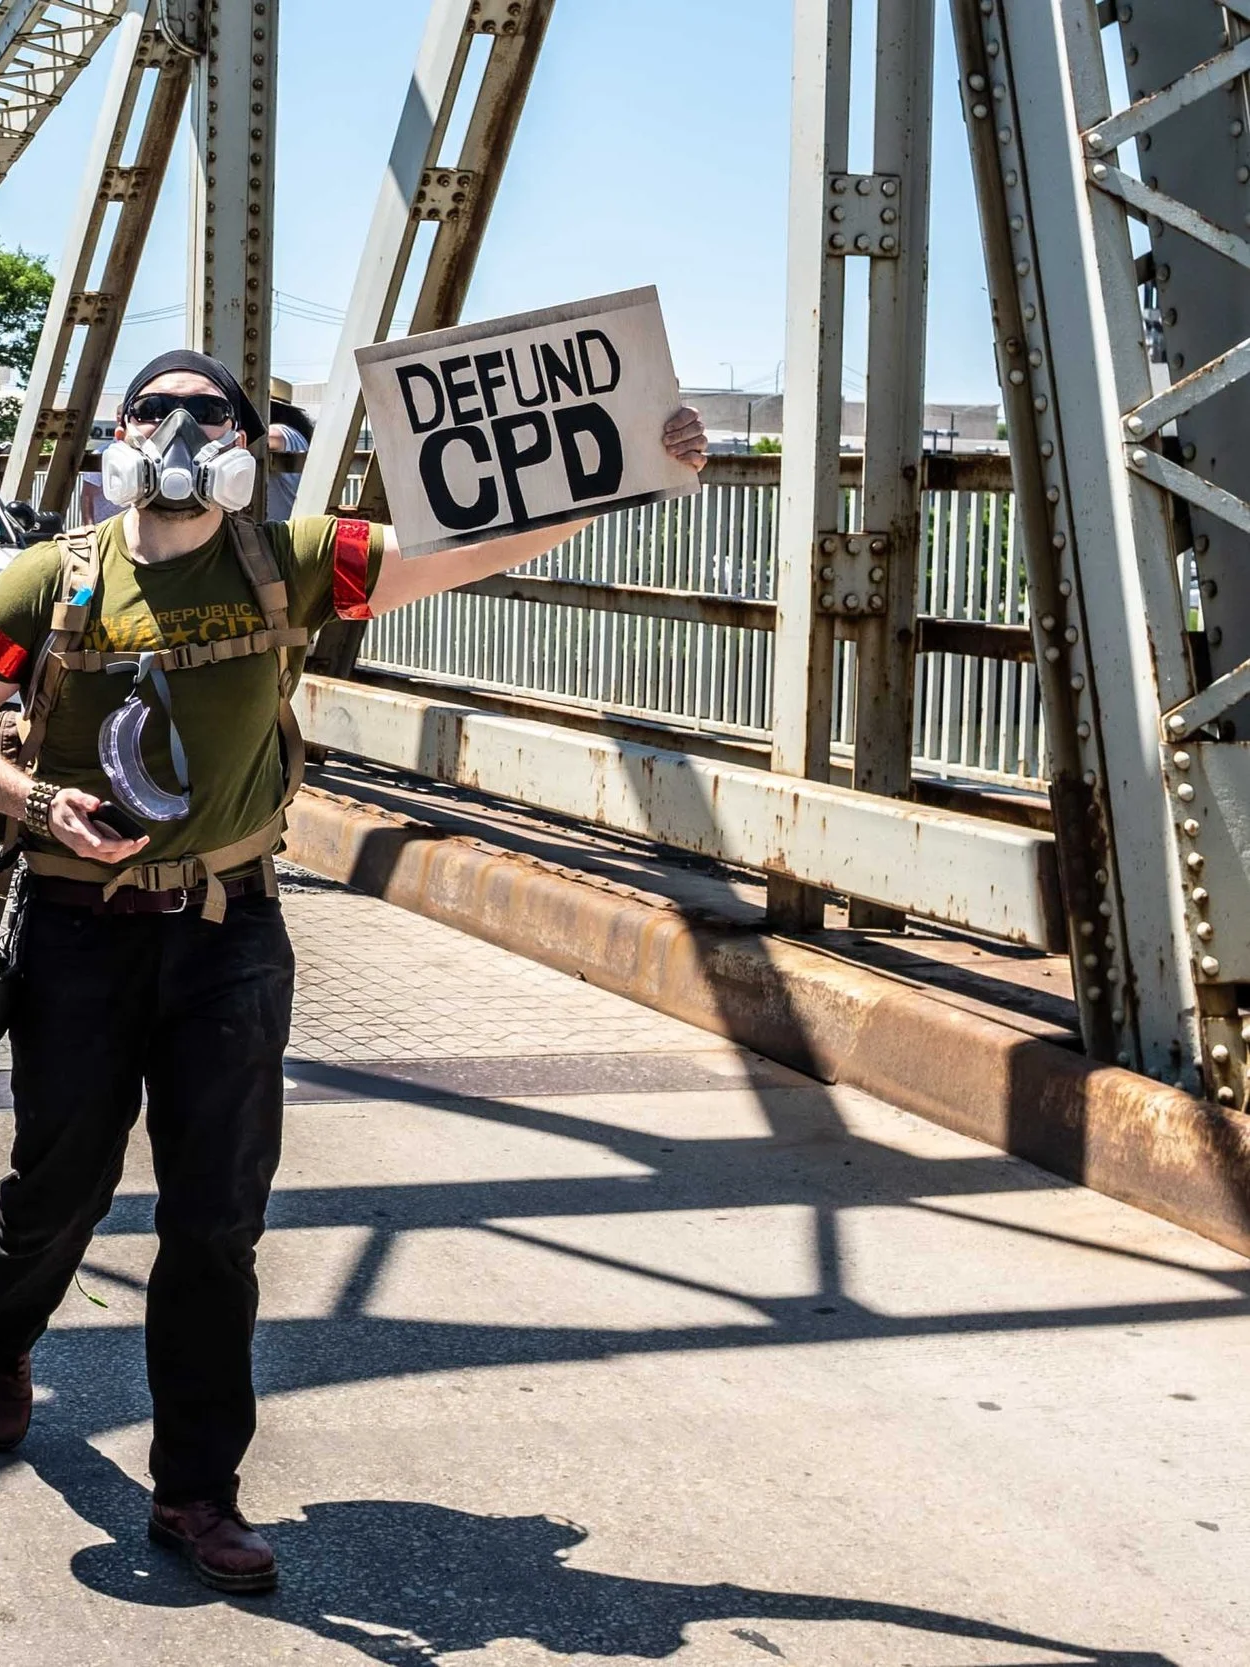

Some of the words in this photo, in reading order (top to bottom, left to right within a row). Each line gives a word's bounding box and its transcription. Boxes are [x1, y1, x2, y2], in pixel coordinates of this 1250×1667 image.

[395, 329, 621, 434] DEFUND
[419, 401, 623, 530] CPD
[156, 603, 253, 625] REPUBLIC
[201, 615, 265, 640] CIT
